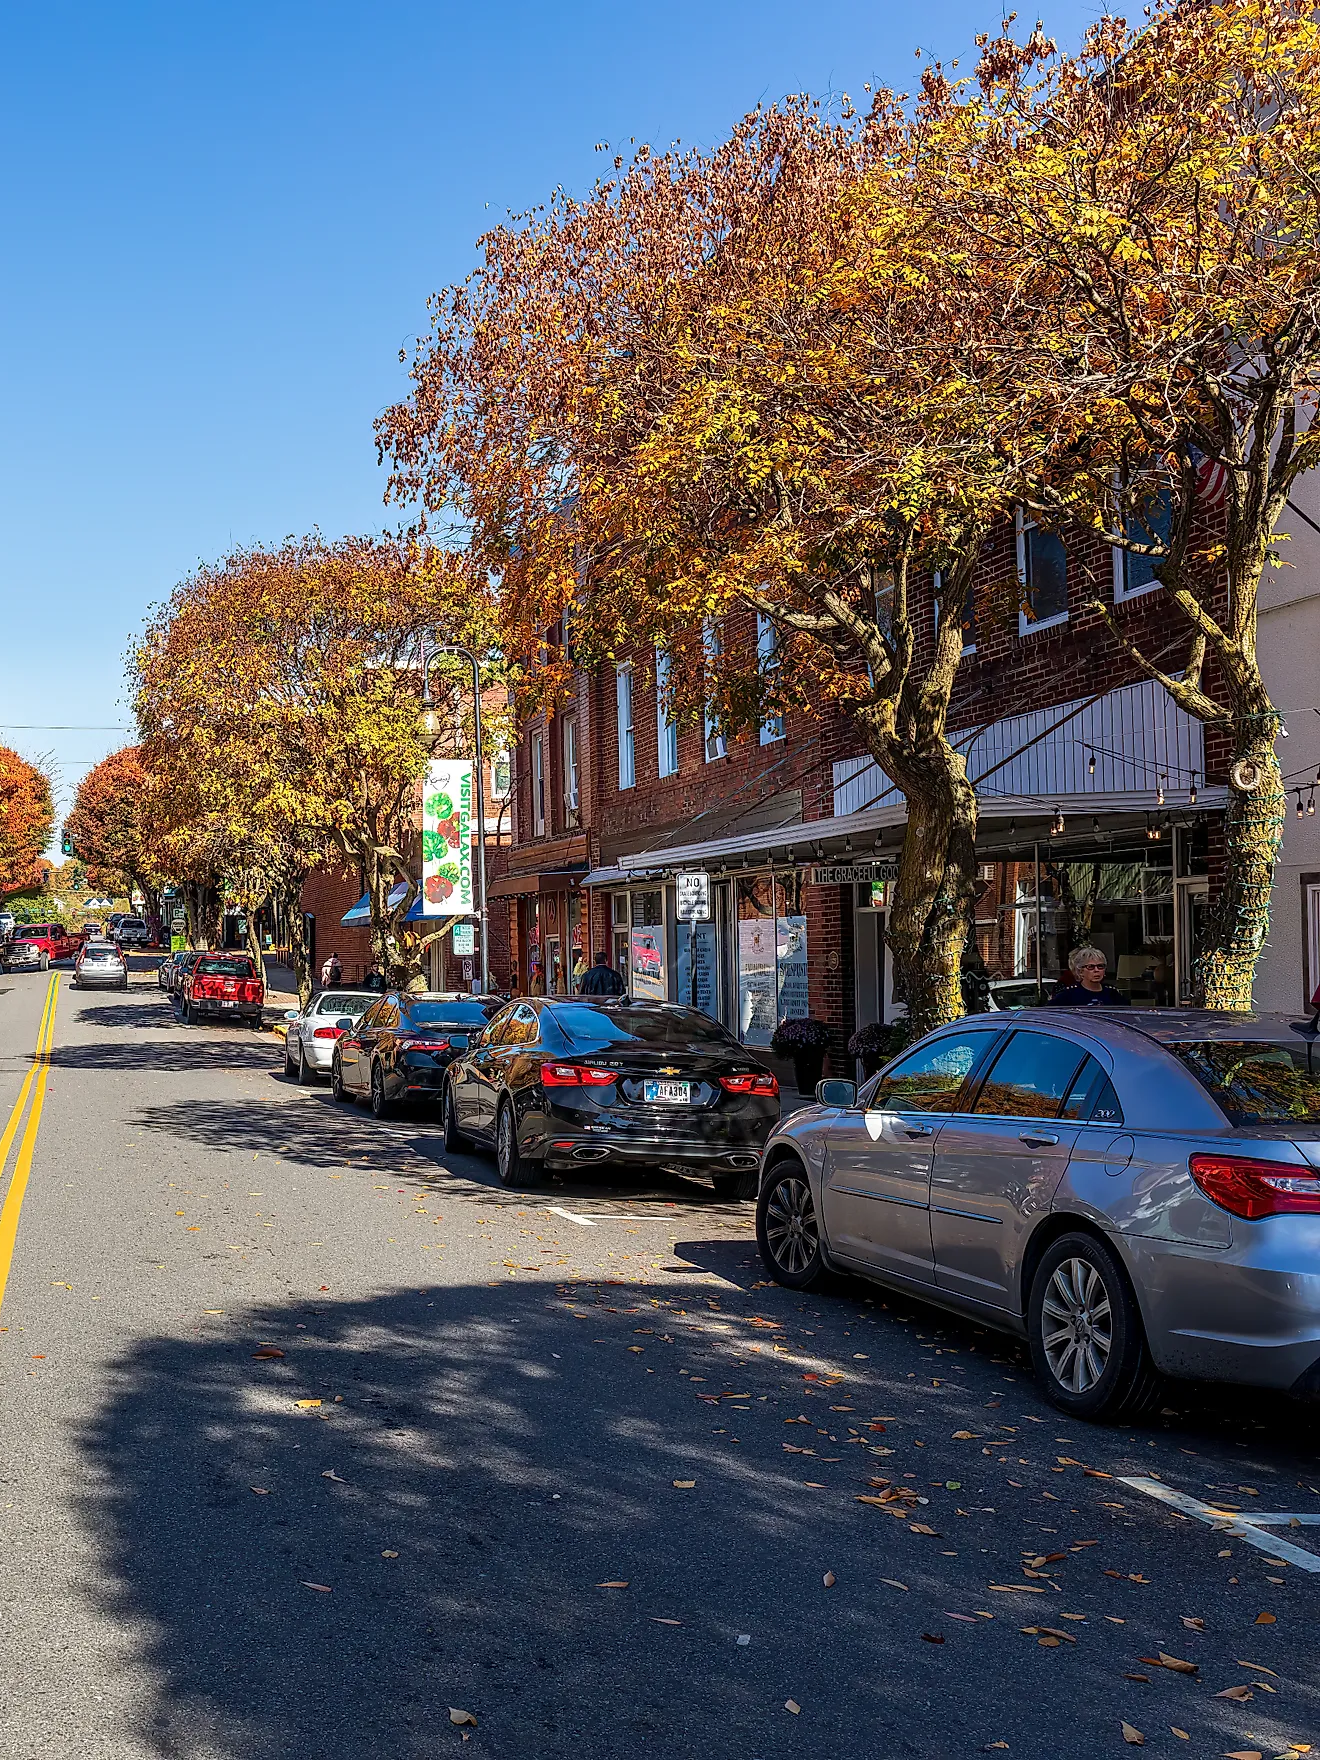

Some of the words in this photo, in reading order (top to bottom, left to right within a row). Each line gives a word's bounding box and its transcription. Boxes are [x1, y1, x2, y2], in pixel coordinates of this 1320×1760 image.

[460, 772, 472, 905] VISITGALAX.COM
[816, 868, 834, 882] THE
[834, 866, 879, 882] GRACEFUL
[686, 877, 700, 888] NO
[660, 1086, 688, 1097] AFA304
